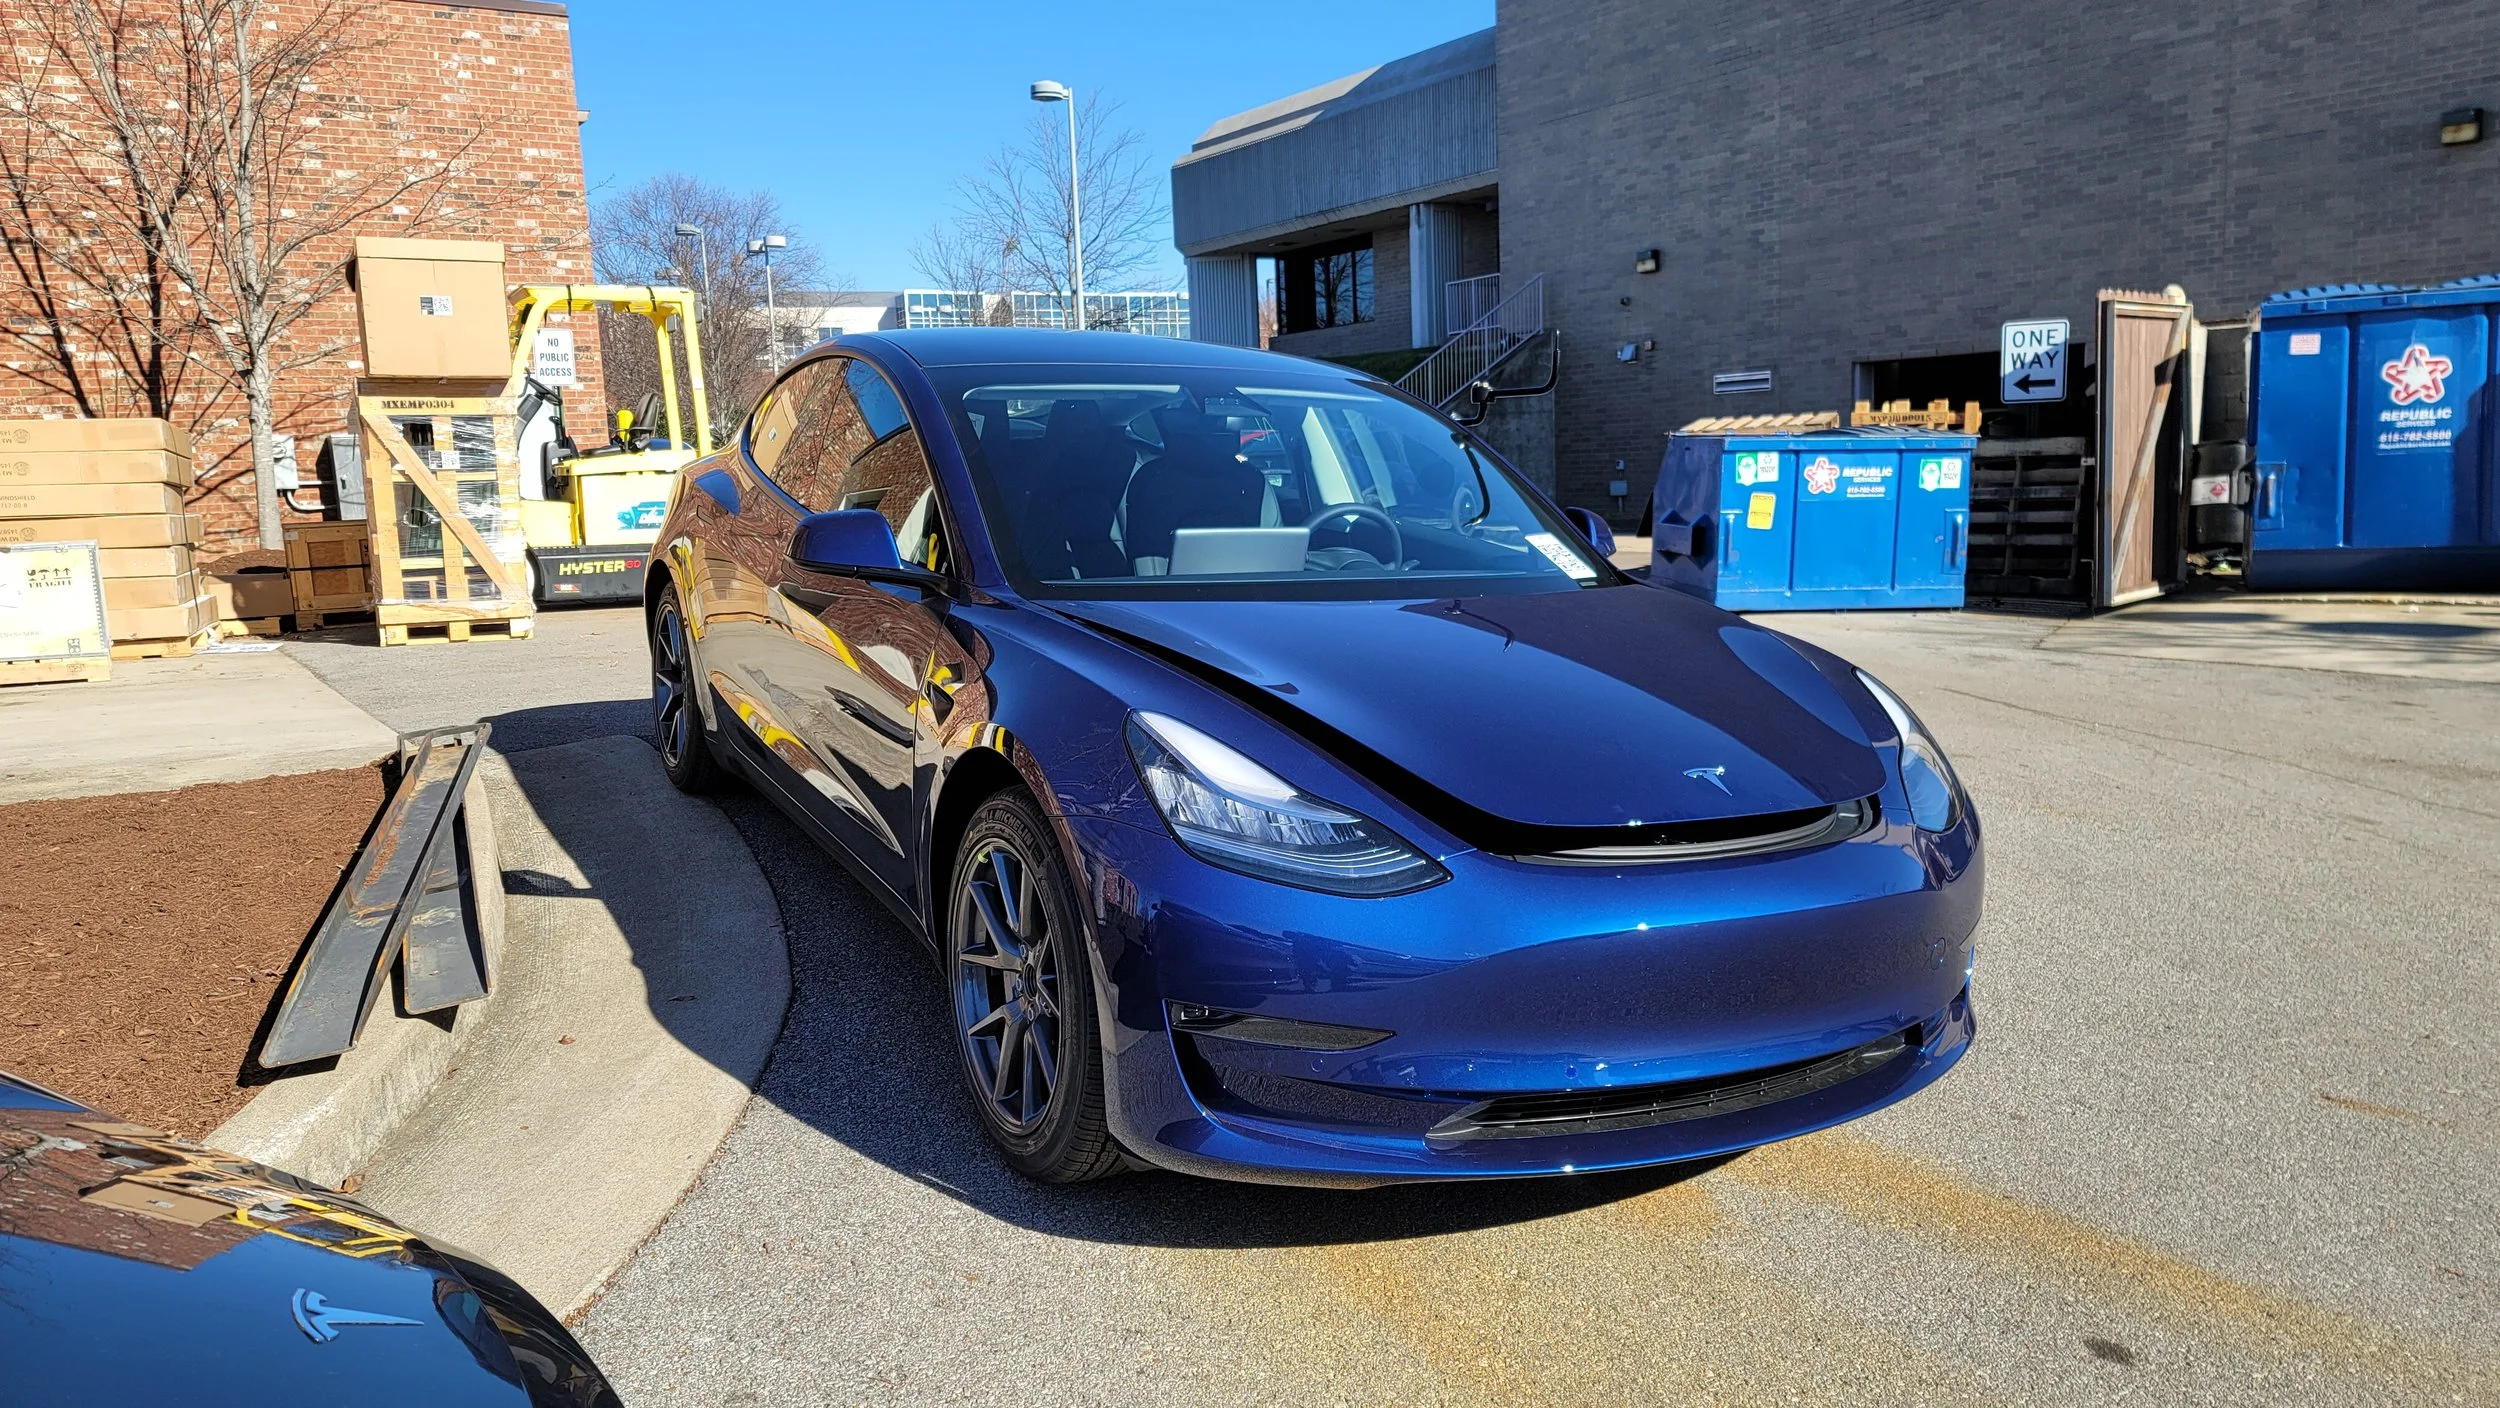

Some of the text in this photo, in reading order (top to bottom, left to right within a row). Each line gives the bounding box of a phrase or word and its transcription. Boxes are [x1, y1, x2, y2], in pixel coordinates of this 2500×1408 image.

[547, 337, 559, 347] NO
[2012, 328, 2058, 348] ONE
[539, 352, 569, 362] PUBLIC
[2011, 350, 2060, 370] WAY
[539, 367, 572, 377] ACCESS
[381, 399, 455, 409] MXEMP0304
[2379, 408, 2452, 422] REPUBLIC
[2395, 420, 2436, 428] SERVICES
[1842, 466, 1893, 477] REPUBLIC
[559, 559, 626, 576] HYSTER
[994, 808, 1035, 847] MICHELIN
